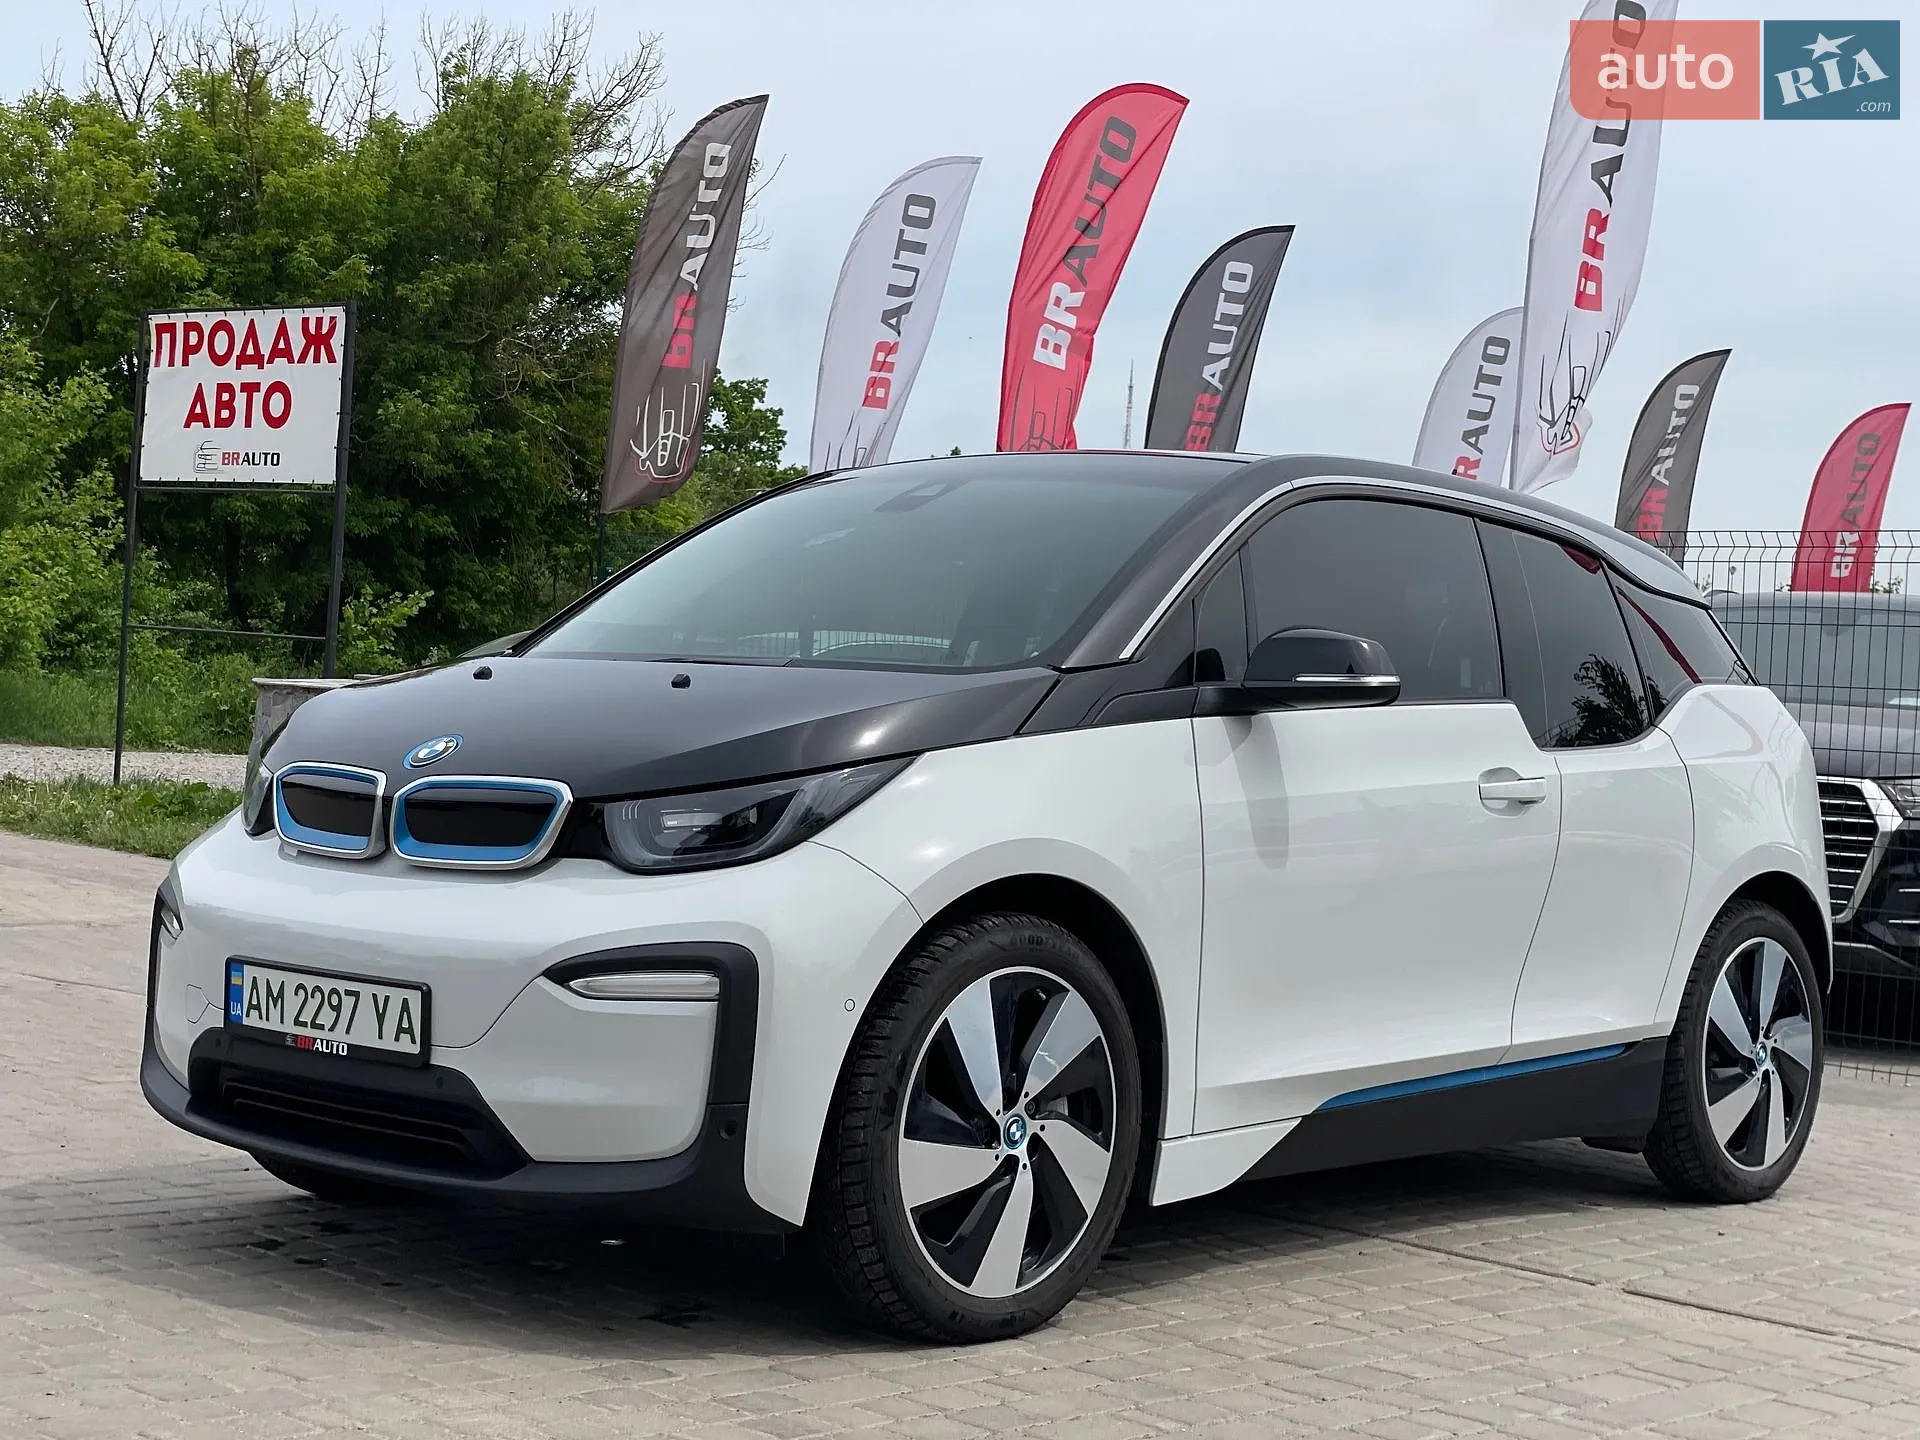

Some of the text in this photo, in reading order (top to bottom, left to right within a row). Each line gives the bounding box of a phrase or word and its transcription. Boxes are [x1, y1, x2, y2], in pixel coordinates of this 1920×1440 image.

[660, 142, 732, 368] BRAUTO
[862, 193, 937, 409] BRAUTO
[1032, 115, 1137, 370] BRAUTO
[153, 315, 338, 370] ПРОДАЖ
[183, 380, 293, 429] АВТО
[1184, 261, 1254, 450] BRAUTO
[1452, 335, 1511, 480] RAUTO
[221, 451, 281, 466] BRAUTO
[1637, 384, 1700, 541] BRAUTO
[1830, 432, 1881, 578] BRAUTO
[230, 1001, 242, 1017] UA
[245, 975, 417, 1045] AM 2297 YA
[296, 1035, 348, 1056] BRAUTO
